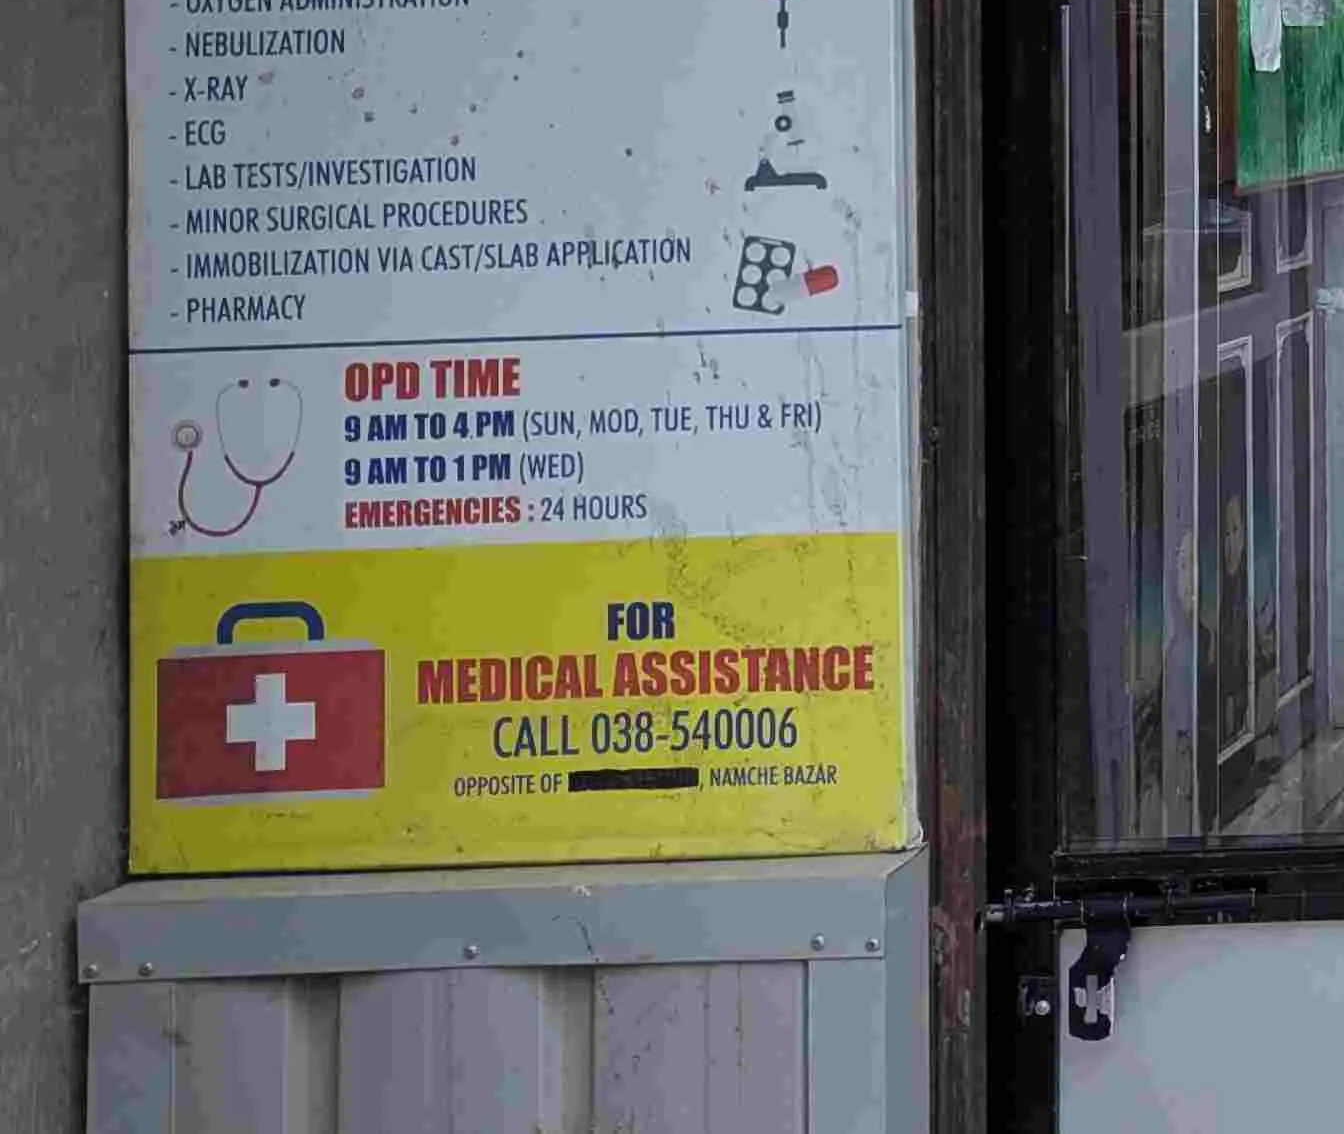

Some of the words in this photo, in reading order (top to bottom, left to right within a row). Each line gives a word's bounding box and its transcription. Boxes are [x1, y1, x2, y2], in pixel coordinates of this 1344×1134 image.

[185, 29, 345, 58] NEBULIZATION
[184, 74, 248, 103] X-RAY
[185, 119, 226, 147] ECG
[186, 164, 226, 191] LAB
[233, 157, 476, 190] TESTS/INVESTIGATION
[186, 209, 260, 235] MINOR
[266, 204, 376, 233] SURGICAL
[383, 199, 528, 229] PROCEDURES
[186, 247, 370, 280] IMMOBILIZATION
[378, 246, 413, 273] VIA
[421, 242, 540, 274] CAST/SLAB
[546, 236, 691, 268] APPLICATION
[186, 294, 306, 324] PHARMACY
[344, 361, 420, 403] OPD
[430, 357, 521, 399] TIME
[344, 415, 361, 443] 9
[367, 414, 407, 442] AM
[414, 412, 447, 440] TO
[453, 411, 470, 439] 4
[476, 410, 515, 438] PM
[522, 409, 583, 443] (SUN,
[590, 408, 643, 438] MOD,
[651, 406, 698, 436] TUE,
[706, 405, 750, 432] THU
[757, 403, 773, 430] &
[781, 401, 822, 434] FRI)
[344, 458, 361, 486] 9
[367, 457, 407, 485] AM
[414, 455, 447, 484] TO
[453, 454, 466, 482] 1
[472, 452, 512, 481] PM
[519, 450, 584, 486] (WED)
[344, 496, 521, 530] EMERGENCIES
[541, 496, 565, 522] 24
[573, 494, 648, 521] HOURS
[606, 601, 676, 642] FOR
[416, 654, 603, 705] MEDICAL
[612, 644, 876, 698] ASSISTANCE
[492, 715, 580, 759] CALL
[590, 705, 799, 755] 038-540006
[453, 774, 536, 797] OPPOSITE
[540, 773, 563, 794] OF
[709, 766, 779, 788] NAMCHE
[784, 764, 838, 785] BAZAR
